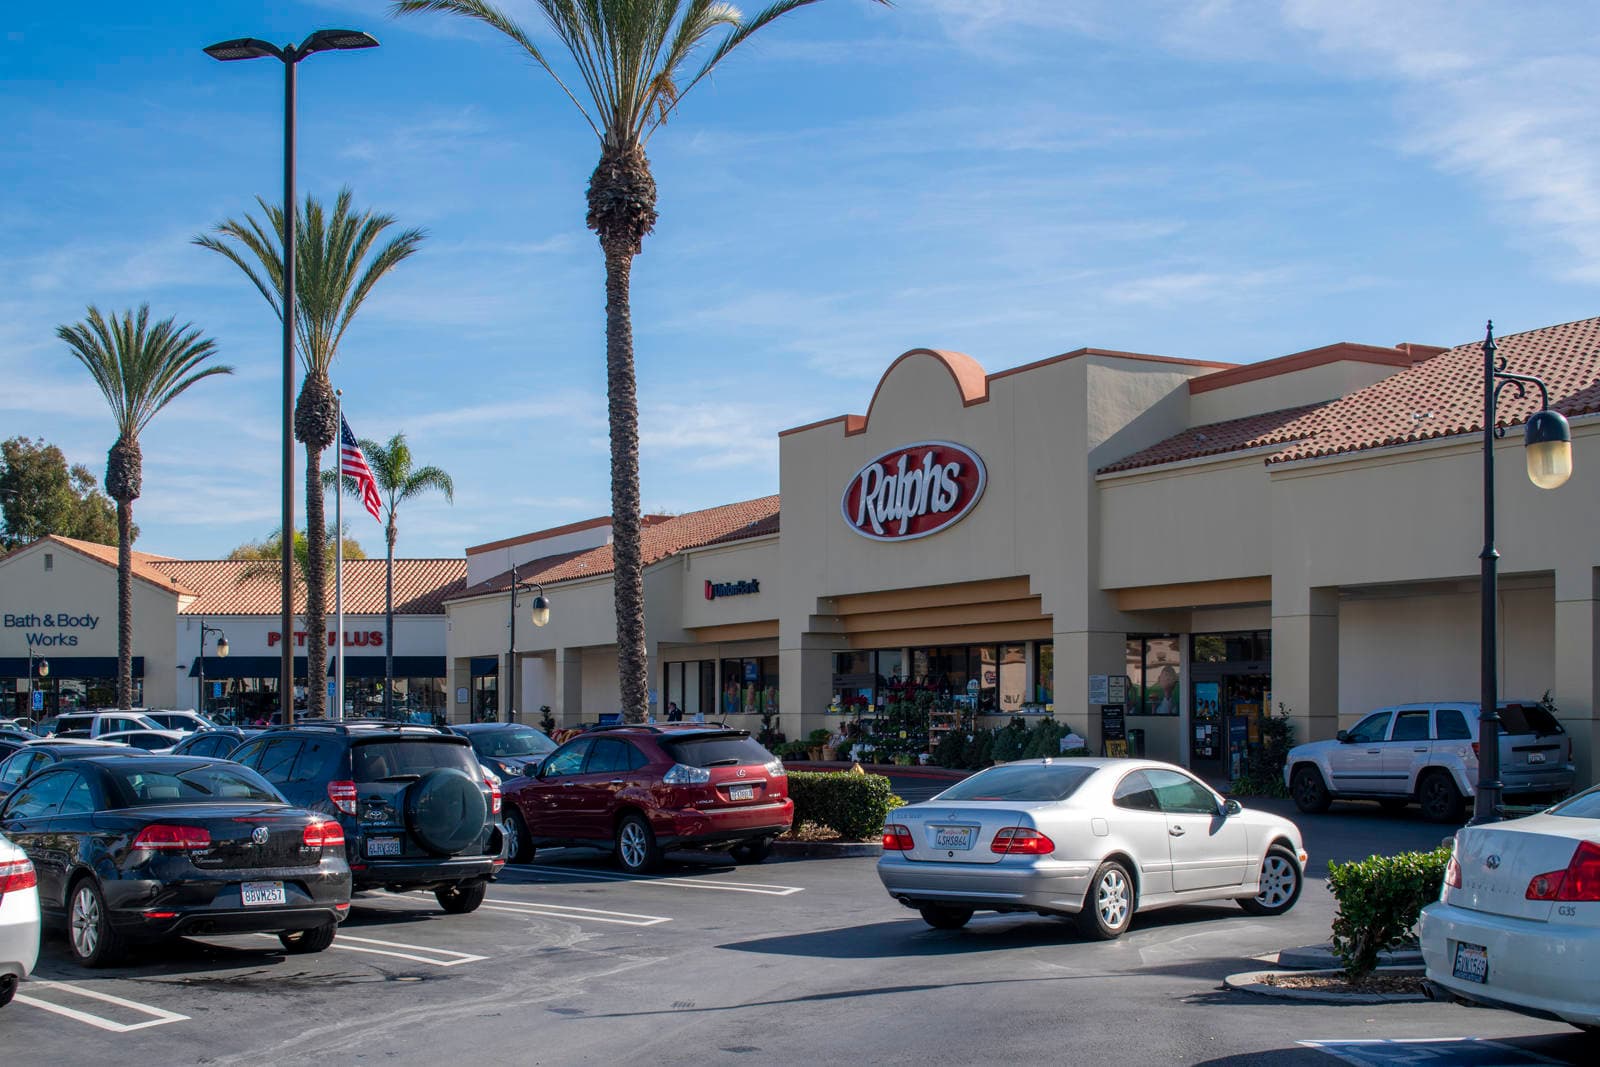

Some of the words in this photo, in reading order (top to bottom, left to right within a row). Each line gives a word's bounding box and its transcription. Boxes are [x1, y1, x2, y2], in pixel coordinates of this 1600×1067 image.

[856, 451, 961, 535] Ralphs
[4, 614, 41, 627] Bath
[43, 614, 55, 627] &
[57, 613, 99, 630] Body
[26, 632, 78, 646] Works
[937, 834, 967, 846] 4SHS864
[245, 889, 282, 902] 8BVM257
[1558, 906, 1576, 917] G35
